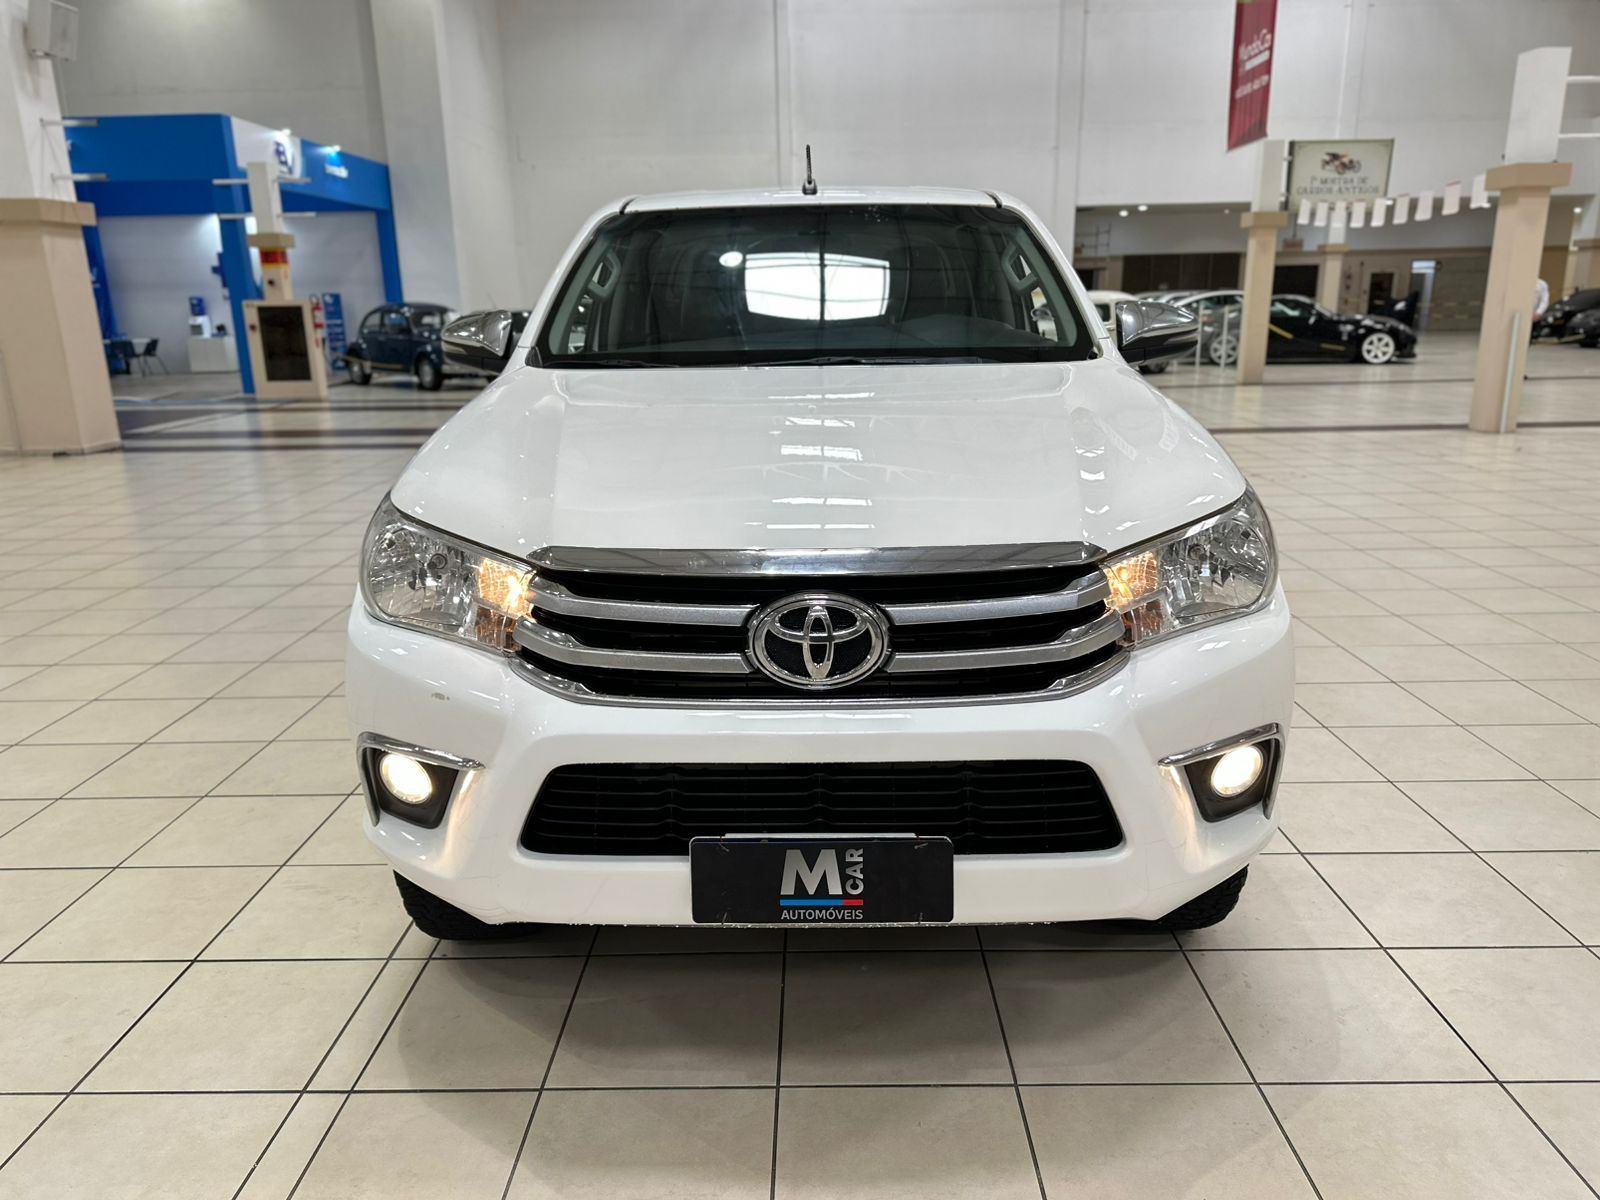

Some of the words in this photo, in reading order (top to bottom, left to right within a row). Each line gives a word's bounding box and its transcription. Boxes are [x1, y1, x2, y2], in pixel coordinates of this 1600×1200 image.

[780, 849, 843, 895] M
[845, 848, 864, 895] CAR
[781, 907, 863, 920] AUTOMÓVEIS
